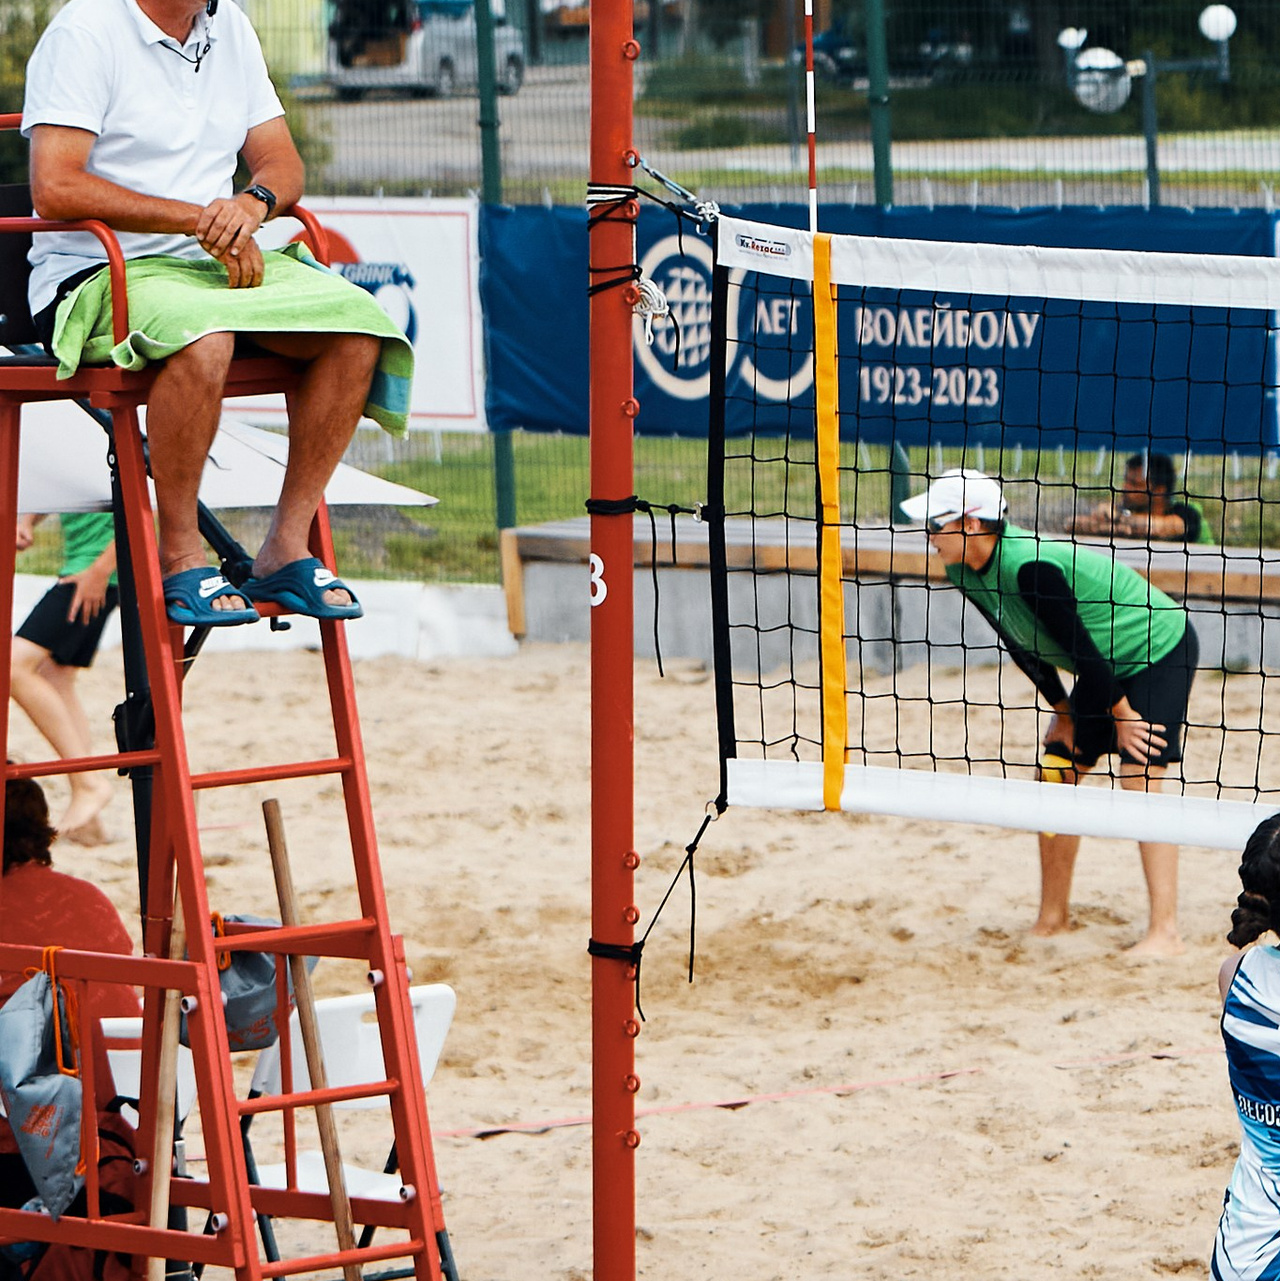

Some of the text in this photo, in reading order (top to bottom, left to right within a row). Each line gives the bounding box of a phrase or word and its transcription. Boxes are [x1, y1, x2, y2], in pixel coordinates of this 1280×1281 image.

[751, 298, 802, 335] ЛЕТ
[855, 302, 1041, 350] ВОЛЕЙБОЛУ
[857, 366, 1000, 408] 1923-2023
